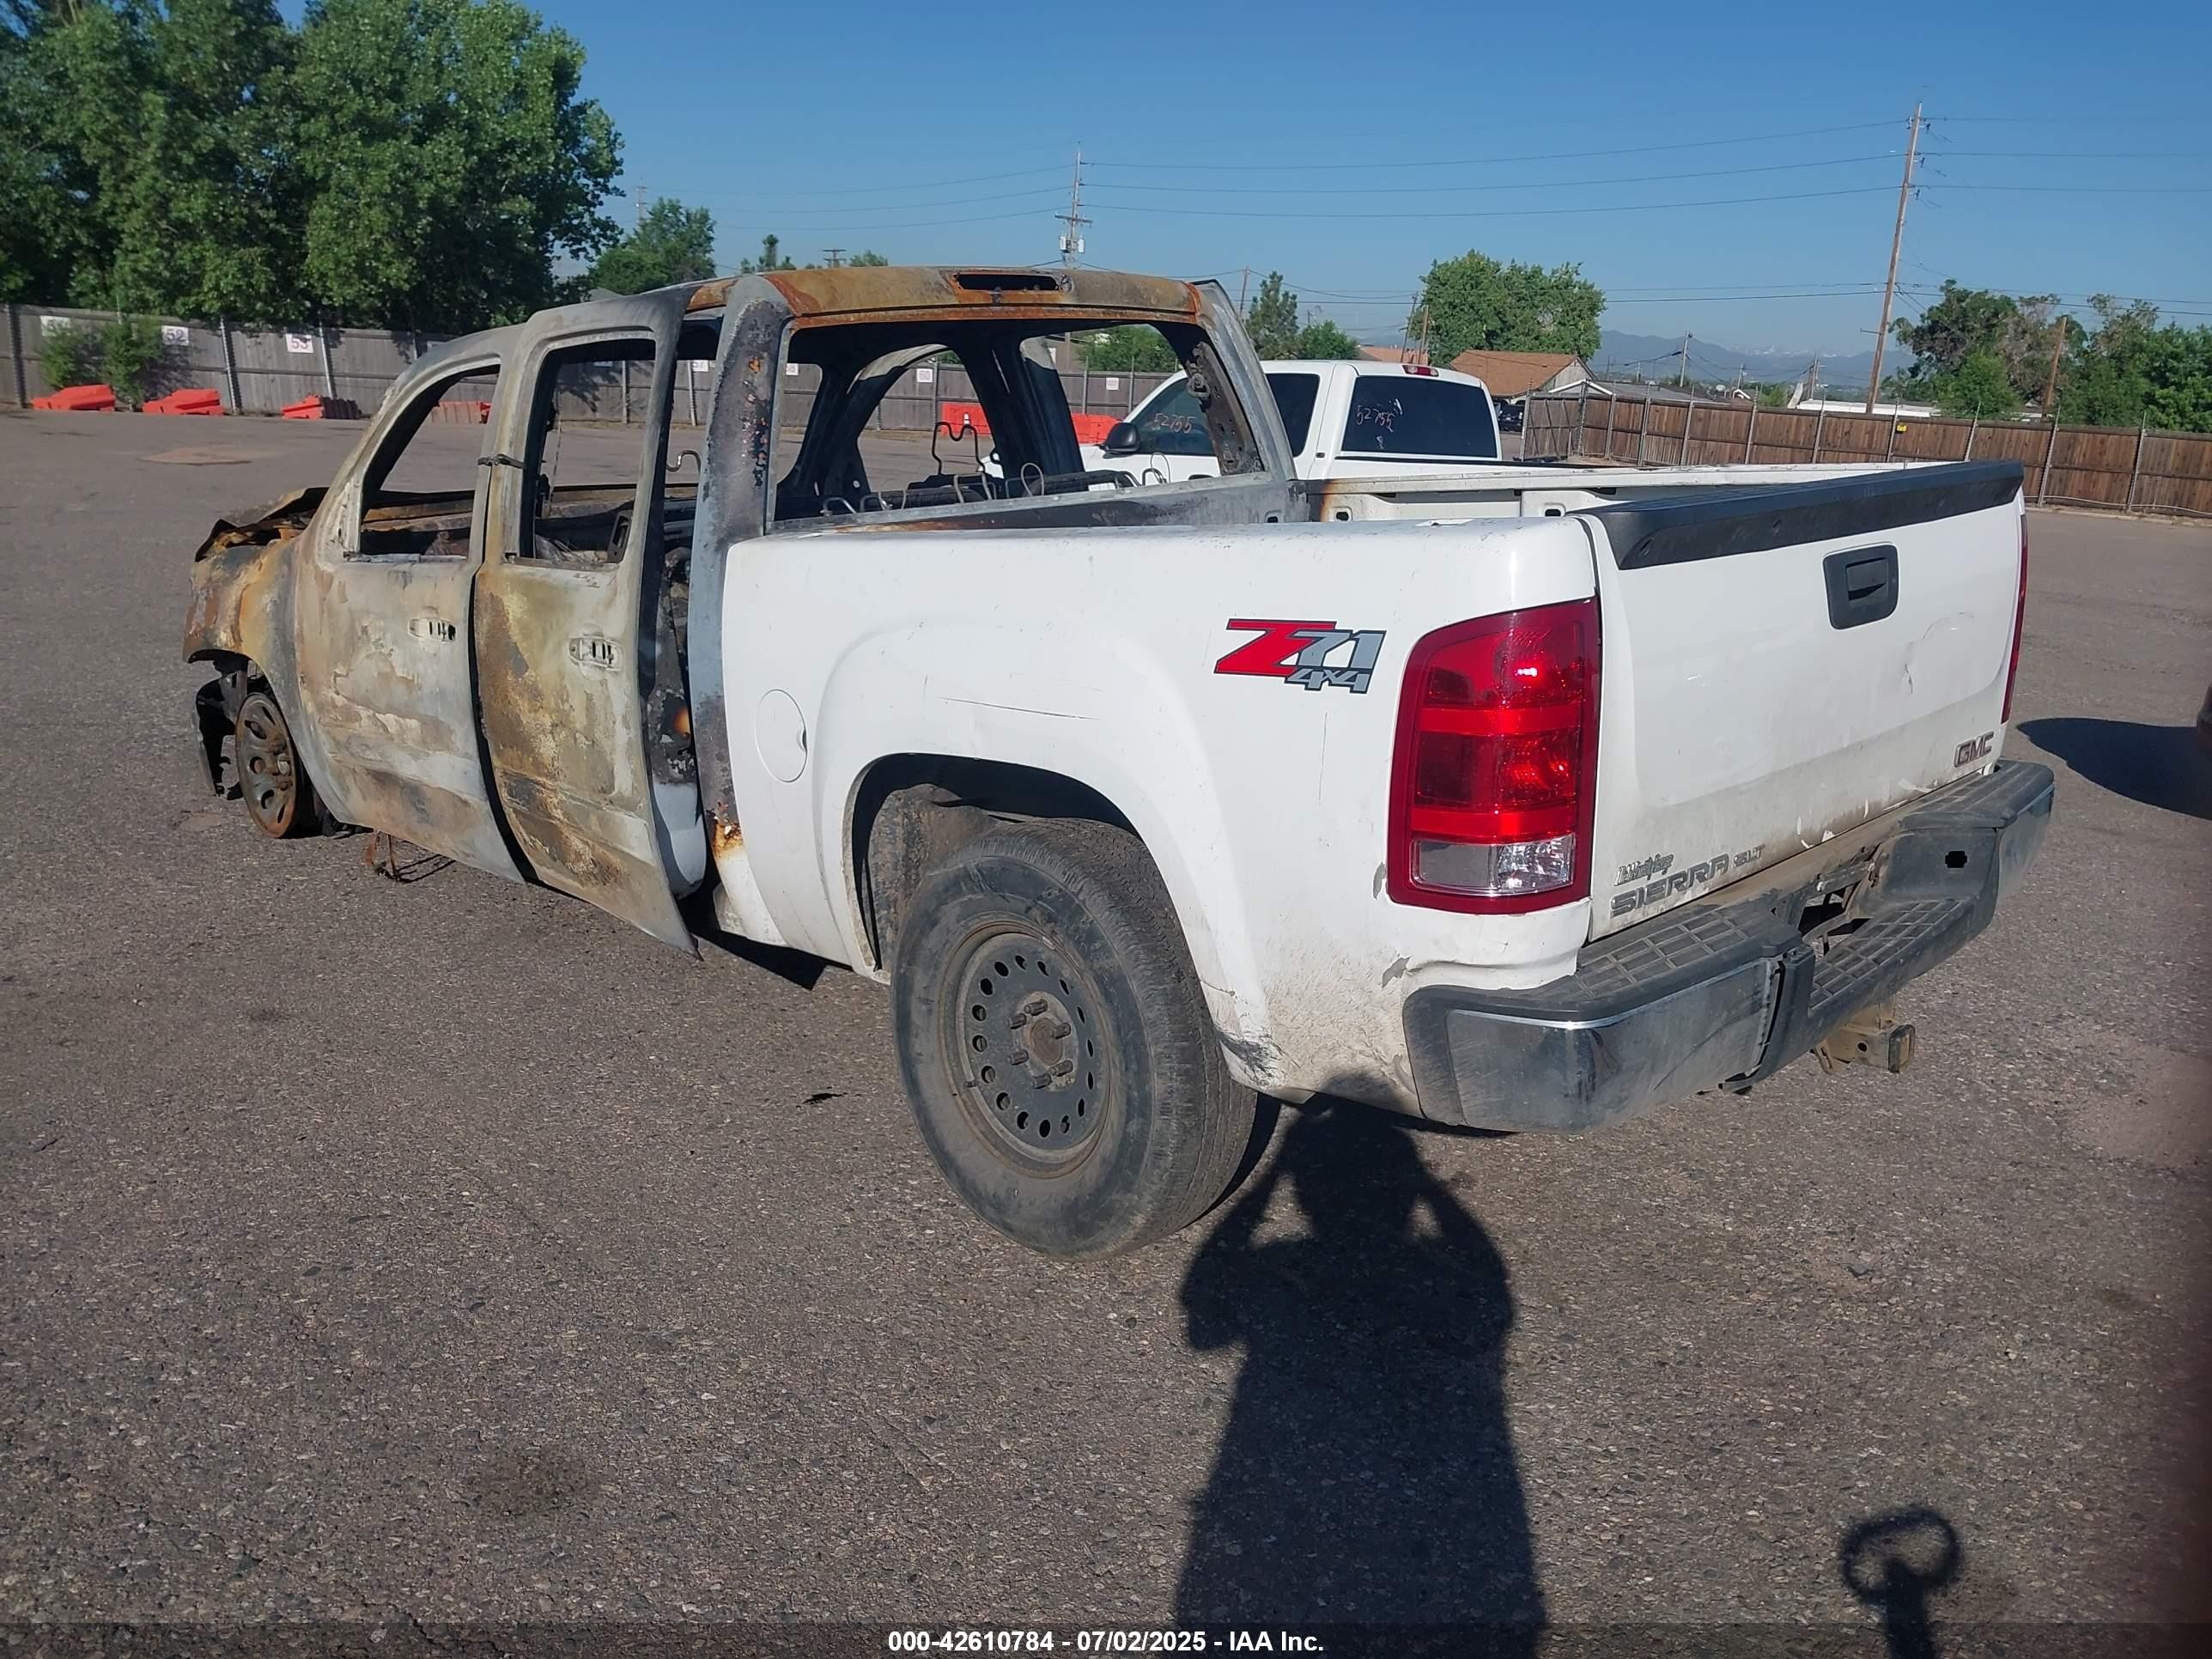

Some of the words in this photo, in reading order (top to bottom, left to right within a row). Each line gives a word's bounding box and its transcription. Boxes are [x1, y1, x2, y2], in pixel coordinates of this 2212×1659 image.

[166, 328, 185, 342] 52
[1213, 618, 1387, 677] Z71
[1954, 731, 1995, 768] GMC
[1610, 854, 1729, 919] SIERRA
